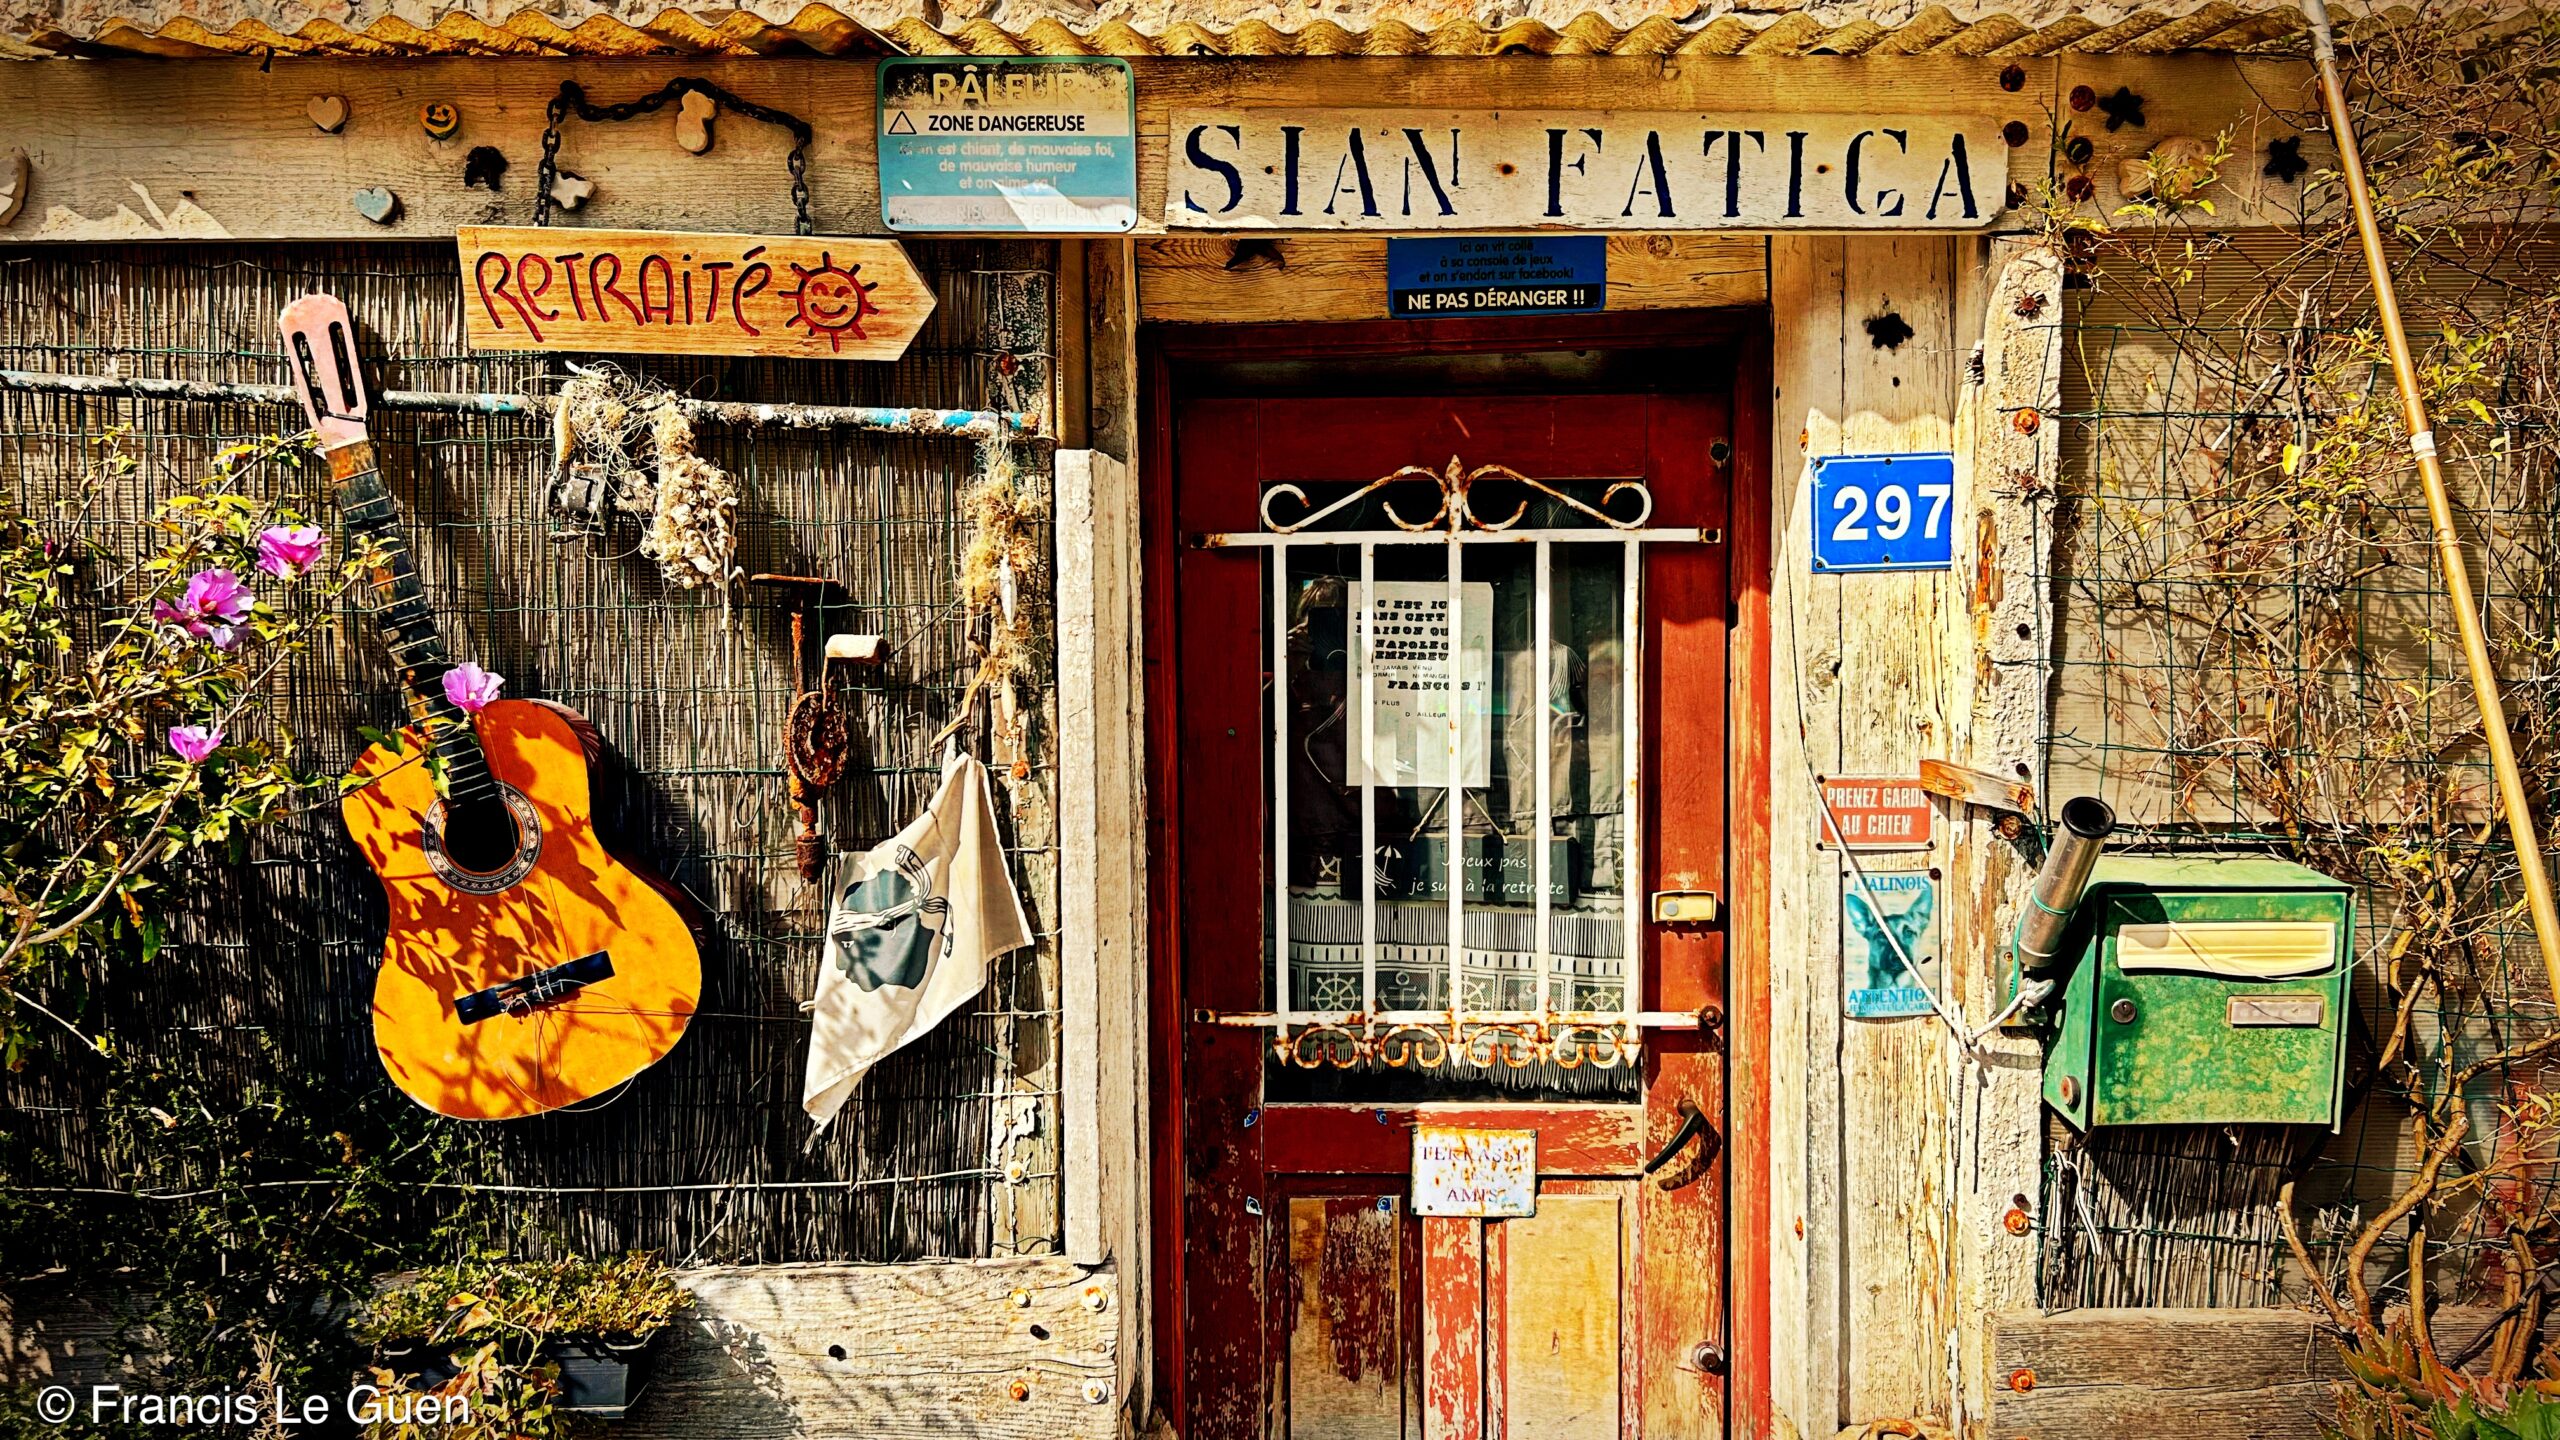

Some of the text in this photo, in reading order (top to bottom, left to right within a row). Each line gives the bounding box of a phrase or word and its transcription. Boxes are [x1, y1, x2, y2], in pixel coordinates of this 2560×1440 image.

[933, 64, 1079, 105] RÂLEUR
[928, 115, 1085, 132] ZONE DANGEREUSE
[1008, 142, 1025, 156] de
[1028, 142, 1091, 156] mauvaise
[1094, 142, 1115, 158] foi,
[939, 159, 1077, 173] de mauvaise humeur
[1185, 124, 1979, 220] SIAN FATIGA
[960, 177, 973, 189] et
[976, 179, 993, 189] on
[1459, 241, 1472, 253] Ici
[1474, 244, 1489, 253] on
[1491, 241, 1504, 252] vit
[1439, 253, 1554, 269] à sa console de jeux
[1419, 271, 1430, 283] et
[1433, 273, 1448, 282] on
[1451, 269, 1497, 282] s'endort
[1498, 270, 1516, 281] sur
[1408, 293, 1432, 310] NE
[1436, 292, 1469, 309] PAS
[1474, 287, 1568, 308] DÉRANGER
[1832, 484, 1951, 541] 297
[1393, 600, 1423, 609] EST
[1826, 787, 1878, 809] PRENEZ
[1841, 814, 1912, 836] AU CHIEN
[1408, 878, 1425, 895] je
[1465, 878, 1475, 893] à
[1446, 1188, 1498, 1204] AMIS
